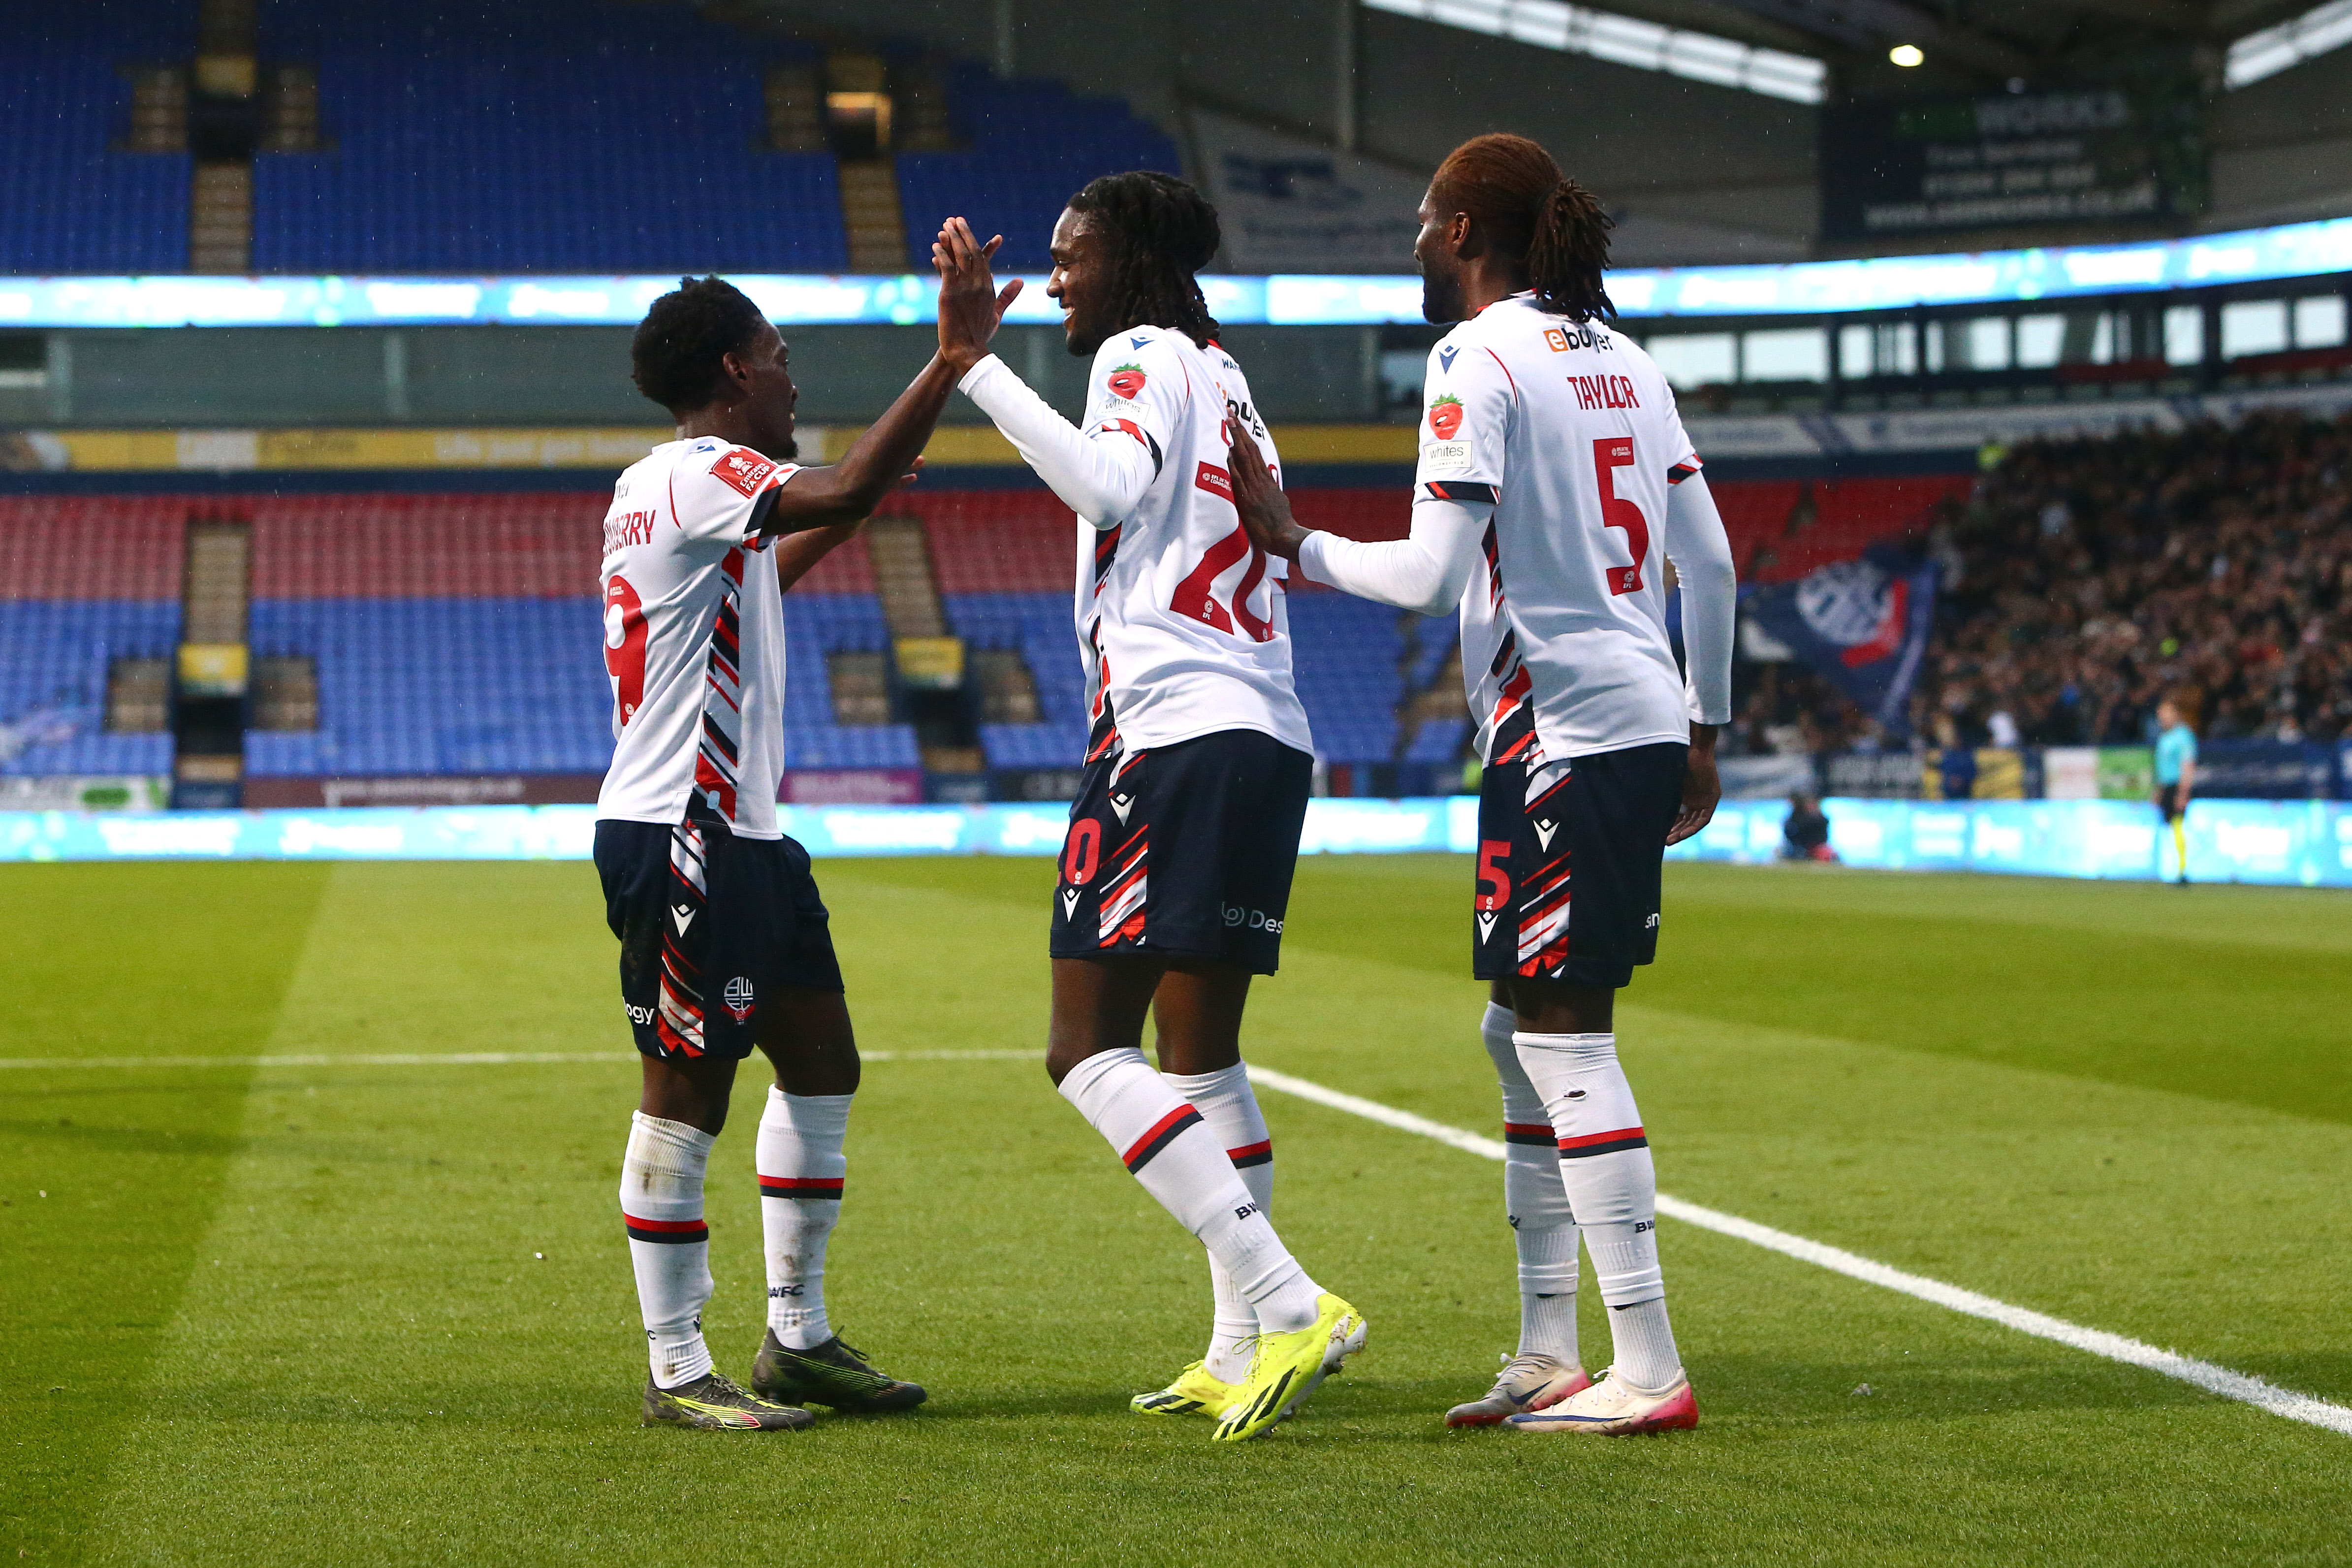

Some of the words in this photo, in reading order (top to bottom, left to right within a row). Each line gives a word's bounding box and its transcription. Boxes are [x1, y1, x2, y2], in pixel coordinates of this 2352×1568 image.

[1543, 326, 1613, 353] ebuyer
[1106, 398, 1141, 413] whites
[1567, 374, 1640, 410] TAYLOR
[1430, 445, 1463, 459] whites
[739, 463, 766, 487] Emirates
[745, 480, 757, 492] FA
[754, 465, 770, 480] CUP
[1593, 437, 1649, 596] 5
[1202, 612, 1210, 620] EFL
[1475, 839, 1512, 911] 5
